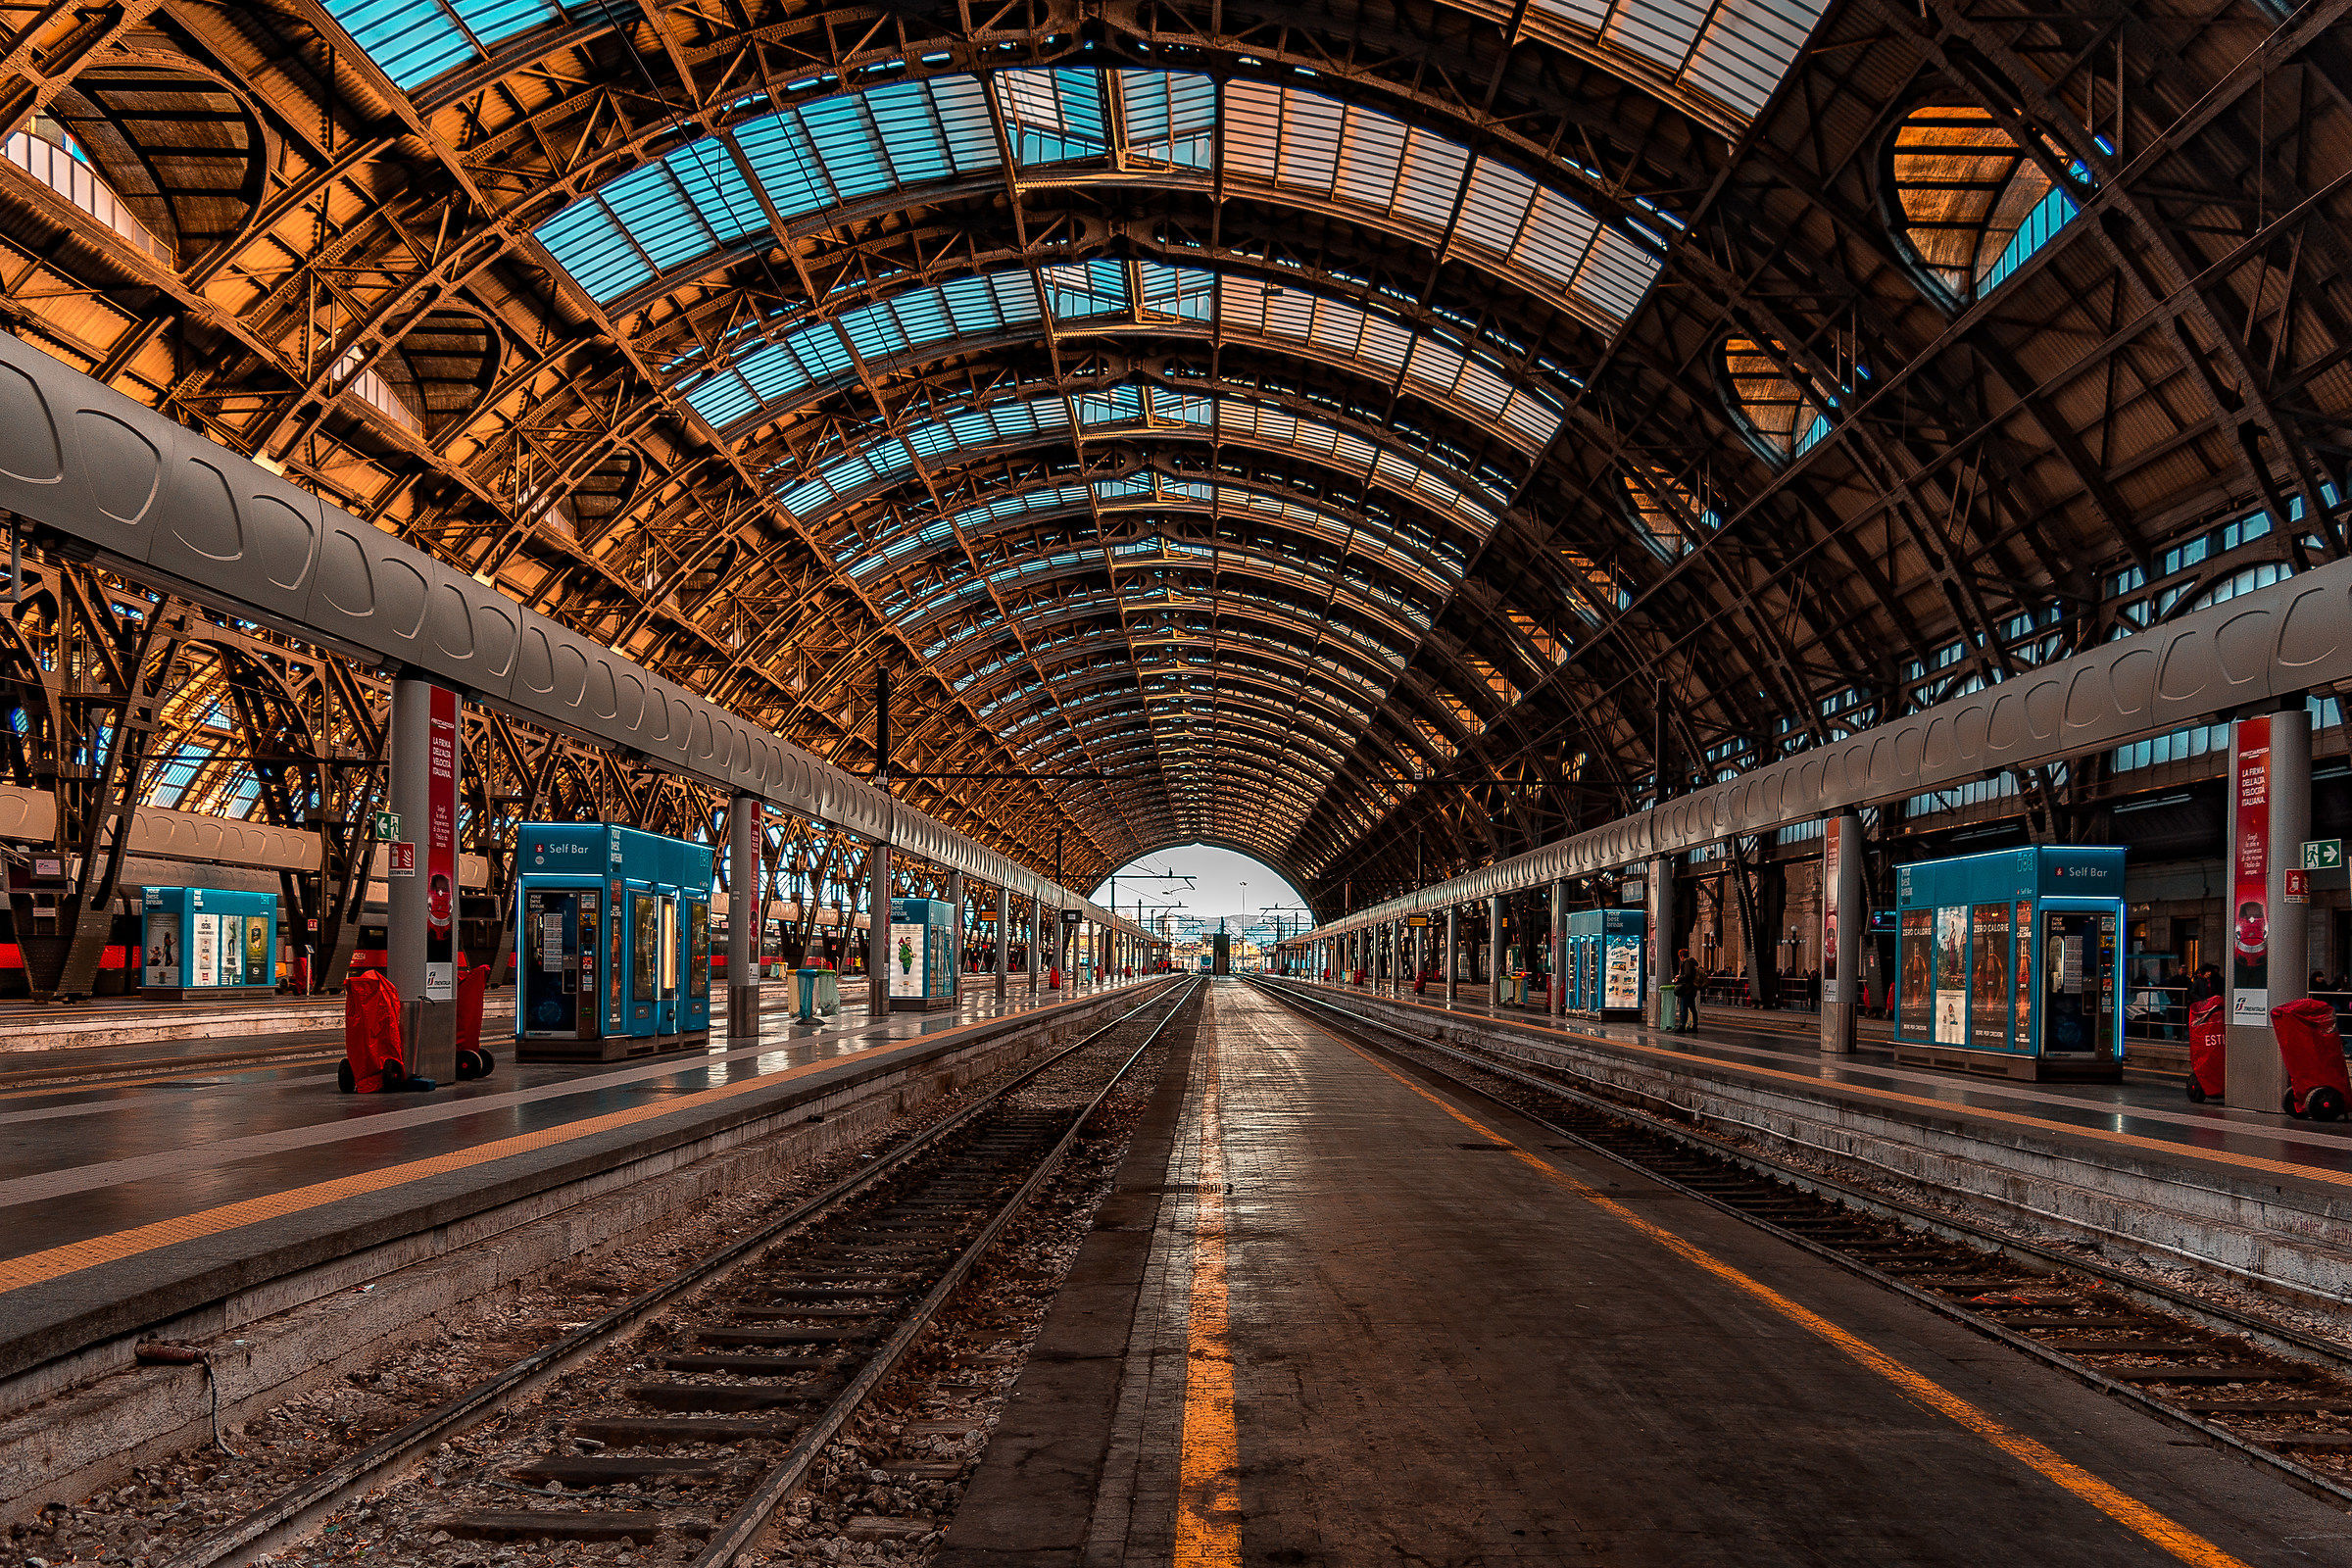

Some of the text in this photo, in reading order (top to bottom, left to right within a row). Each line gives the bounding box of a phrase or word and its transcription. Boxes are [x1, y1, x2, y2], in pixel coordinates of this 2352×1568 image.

[2242, 768, 2248, 777] LA
[549, 844, 589, 854] Self Bar
[2069, 867, 2108, 877] Self Bar
[1902, 927, 1932, 937] ZERO CALORIE
[1974, 922, 2009, 934] ZERO CALORIE
